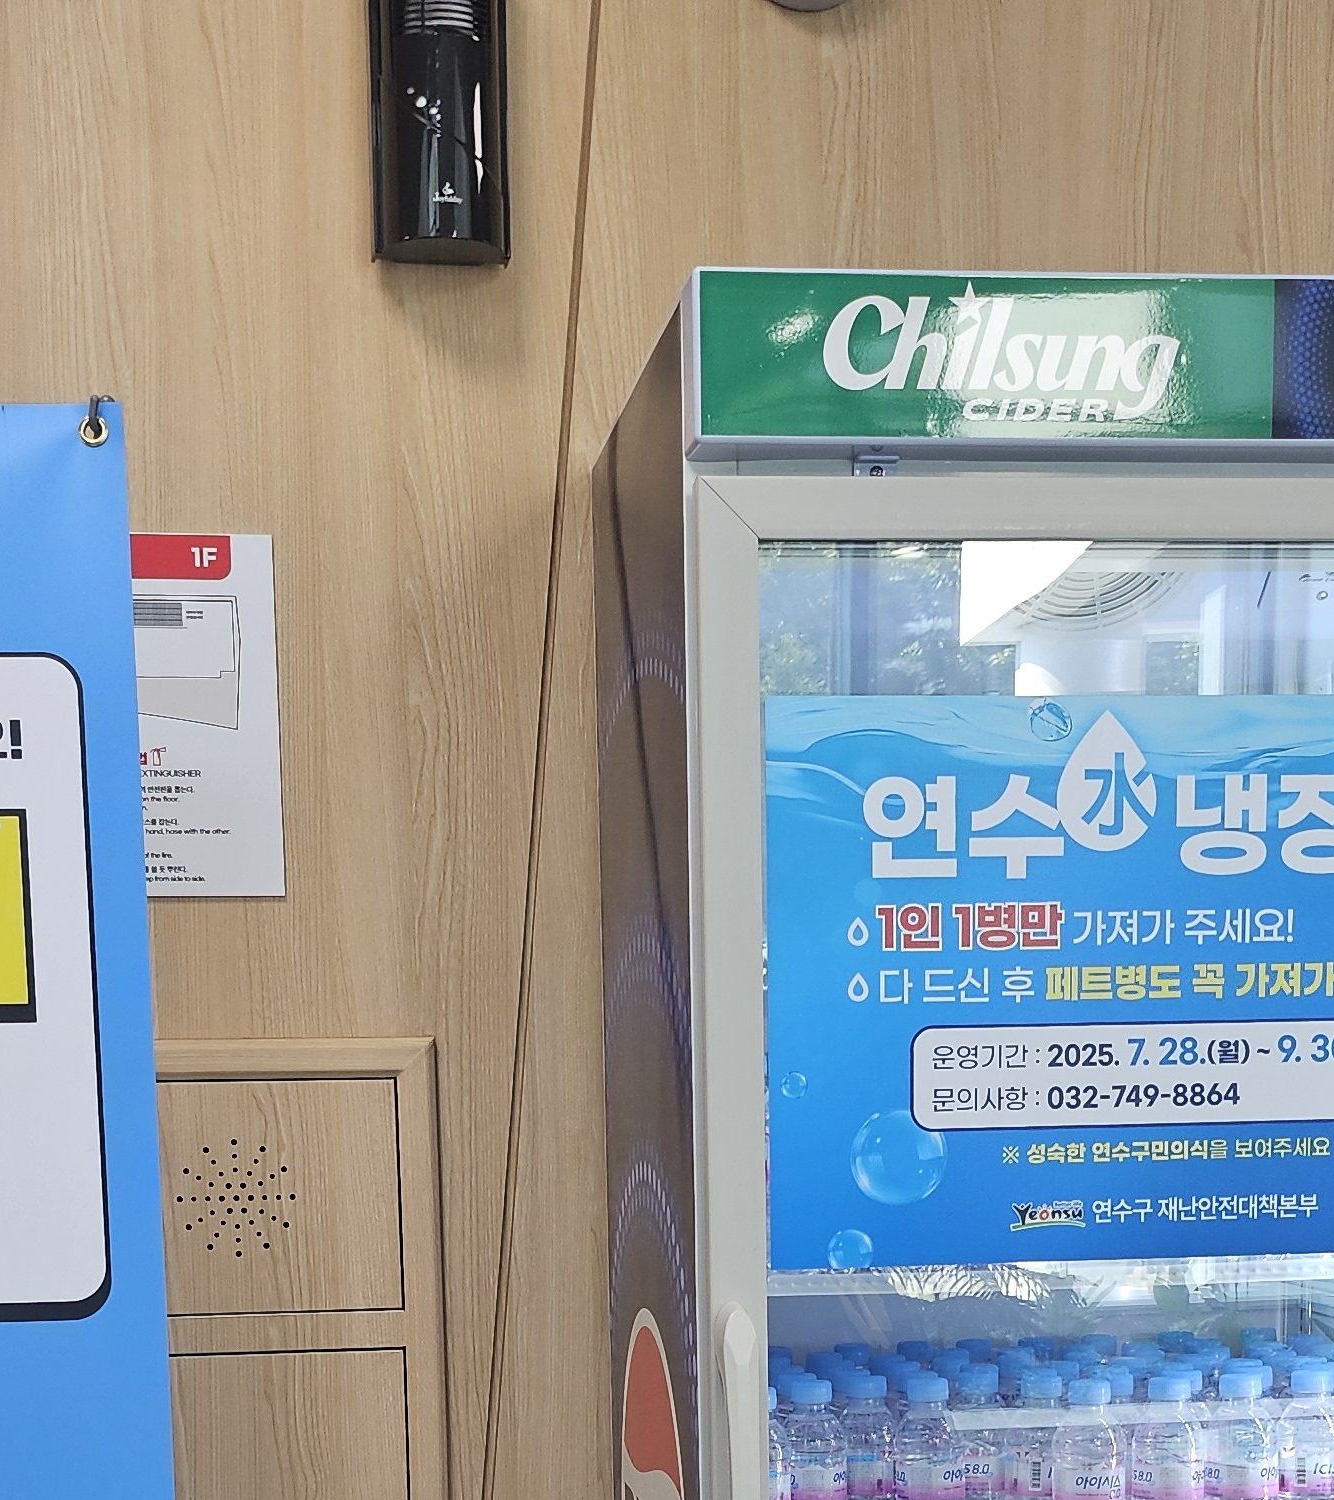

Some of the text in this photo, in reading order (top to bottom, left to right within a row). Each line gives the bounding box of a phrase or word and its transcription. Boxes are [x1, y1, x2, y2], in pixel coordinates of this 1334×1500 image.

[823, 280, 1181, 420] Chilsung
[962, 397, 1108, 423] CIDER
[191, 547, 217, 567] 1F
[875, 901, 1294, 951] 1인 1병만 가져가 주세요!
[879, 969, 913, 1003] 다
[923, 967, 990, 1003] 드신
[1001, 967, 1035, 1002] 후
[1045, 964, 1182, 1001] 페트병도
[1191, 962, 1225, 999] 꼭
[932, 1043, 1029, 1070] 운영기간
[1047, 1043, 1120, 1068] 2025.
[1127, 1039, 1150, 1065] 7.
[1158, 1037, 1250, 1066] 28.(월)
[1278, 1035, 1301, 1064] 9.
[932, 1086, 1029, 1112] 문의사항
[1047, 1082, 1240, 1110] 032-749-8864
[1026, 1142, 1086, 1164] 성숙한
[1092, 1139, 1228, 1163] 연수구민의식을
[1234, 1137, 1331, 1159] 보여주세요
[1012, 1202, 1084, 1226] Yeonsu
[1092, 1193, 1319, 1223] 연수구 재난안전대책본부
